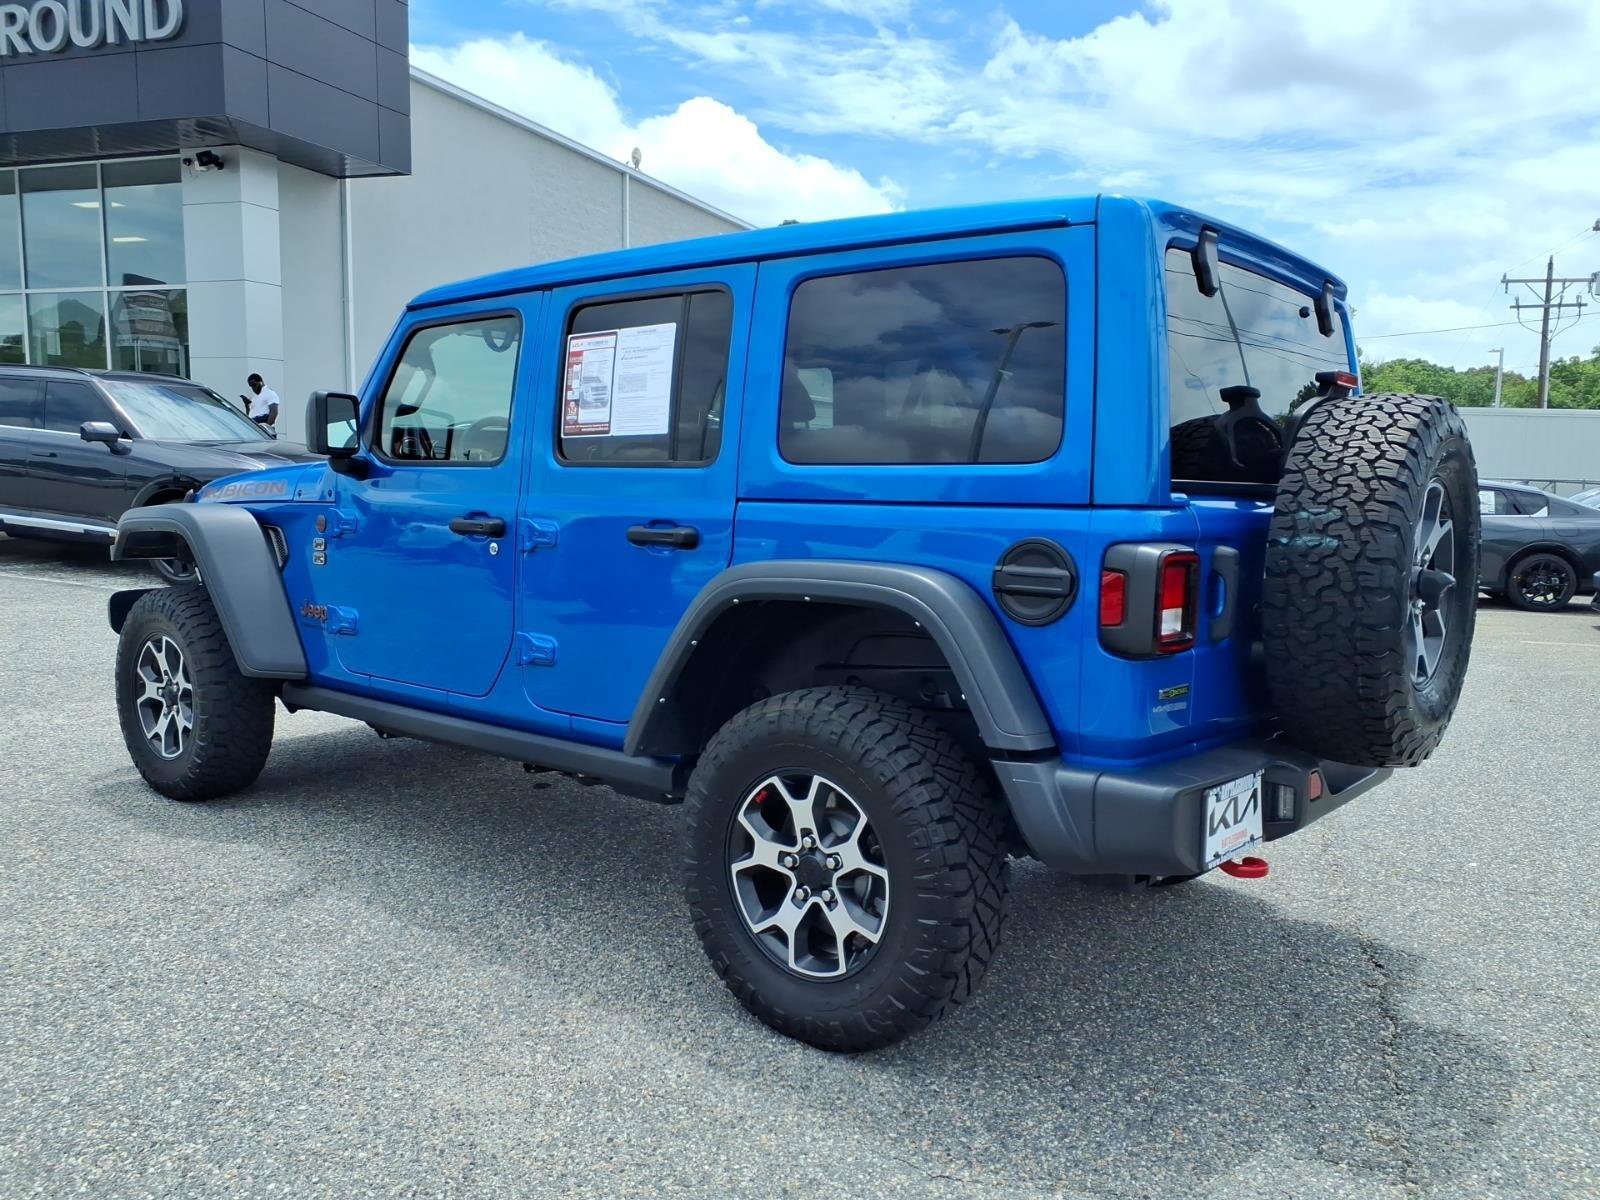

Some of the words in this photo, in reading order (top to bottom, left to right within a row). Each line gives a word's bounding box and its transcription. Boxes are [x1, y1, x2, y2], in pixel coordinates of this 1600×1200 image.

[0, 0, 183, 56] ROUND
[203, 480, 287, 498] RUBICON
[302, 601, 327, 622] Jeep
[1208, 787, 1259, 838] KIA
